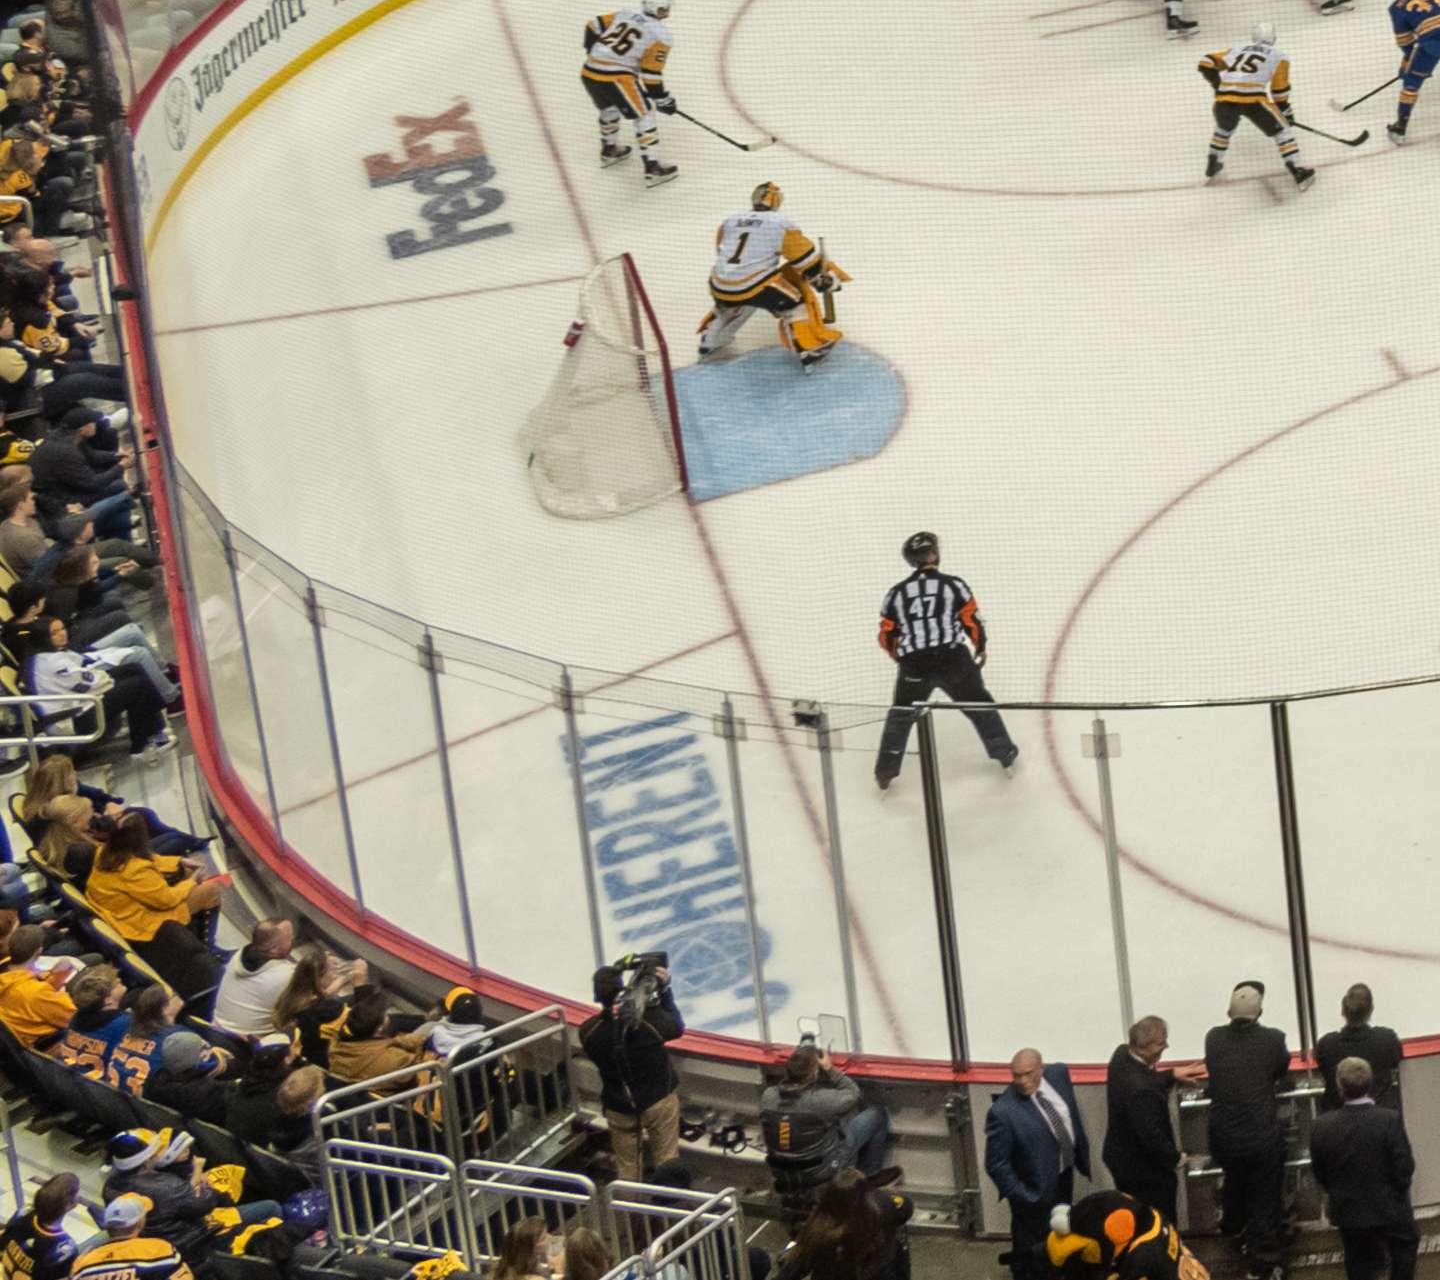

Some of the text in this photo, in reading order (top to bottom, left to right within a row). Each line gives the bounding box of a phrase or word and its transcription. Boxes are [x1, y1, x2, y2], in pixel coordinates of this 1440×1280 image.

[600, 21, 643, 57] 26
[363, 94, 515, 260] FedEx
[727, 231, 751, 264] 1
[909, 594, 937, 620] 47
